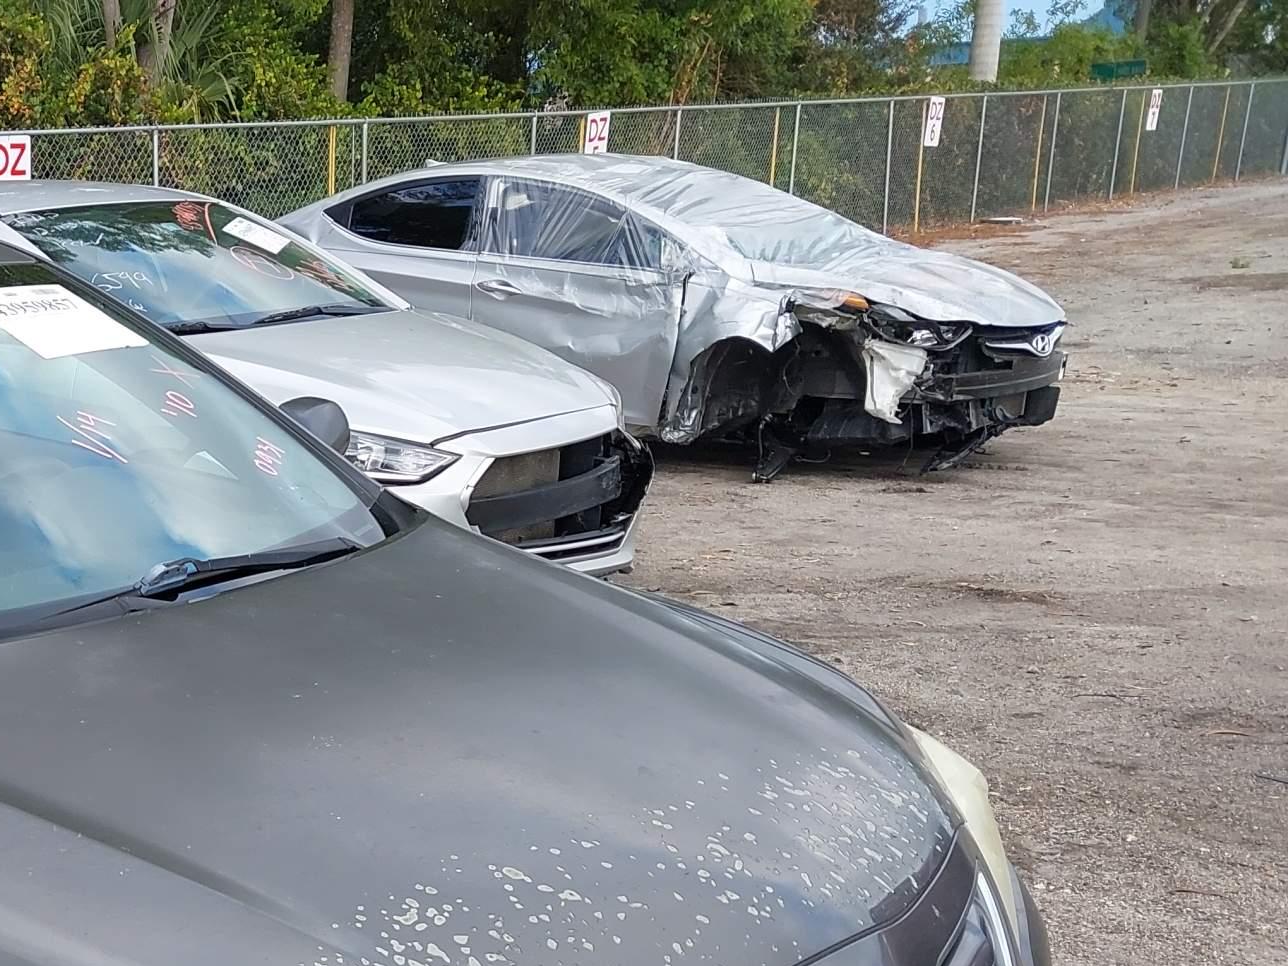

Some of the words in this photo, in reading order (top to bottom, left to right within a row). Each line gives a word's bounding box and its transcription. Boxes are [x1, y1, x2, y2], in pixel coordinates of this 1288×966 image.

[930, 102, 943, 120] DZ
[588, 116, 607, 142] DZ
[930, 124, 936, 141] 6
